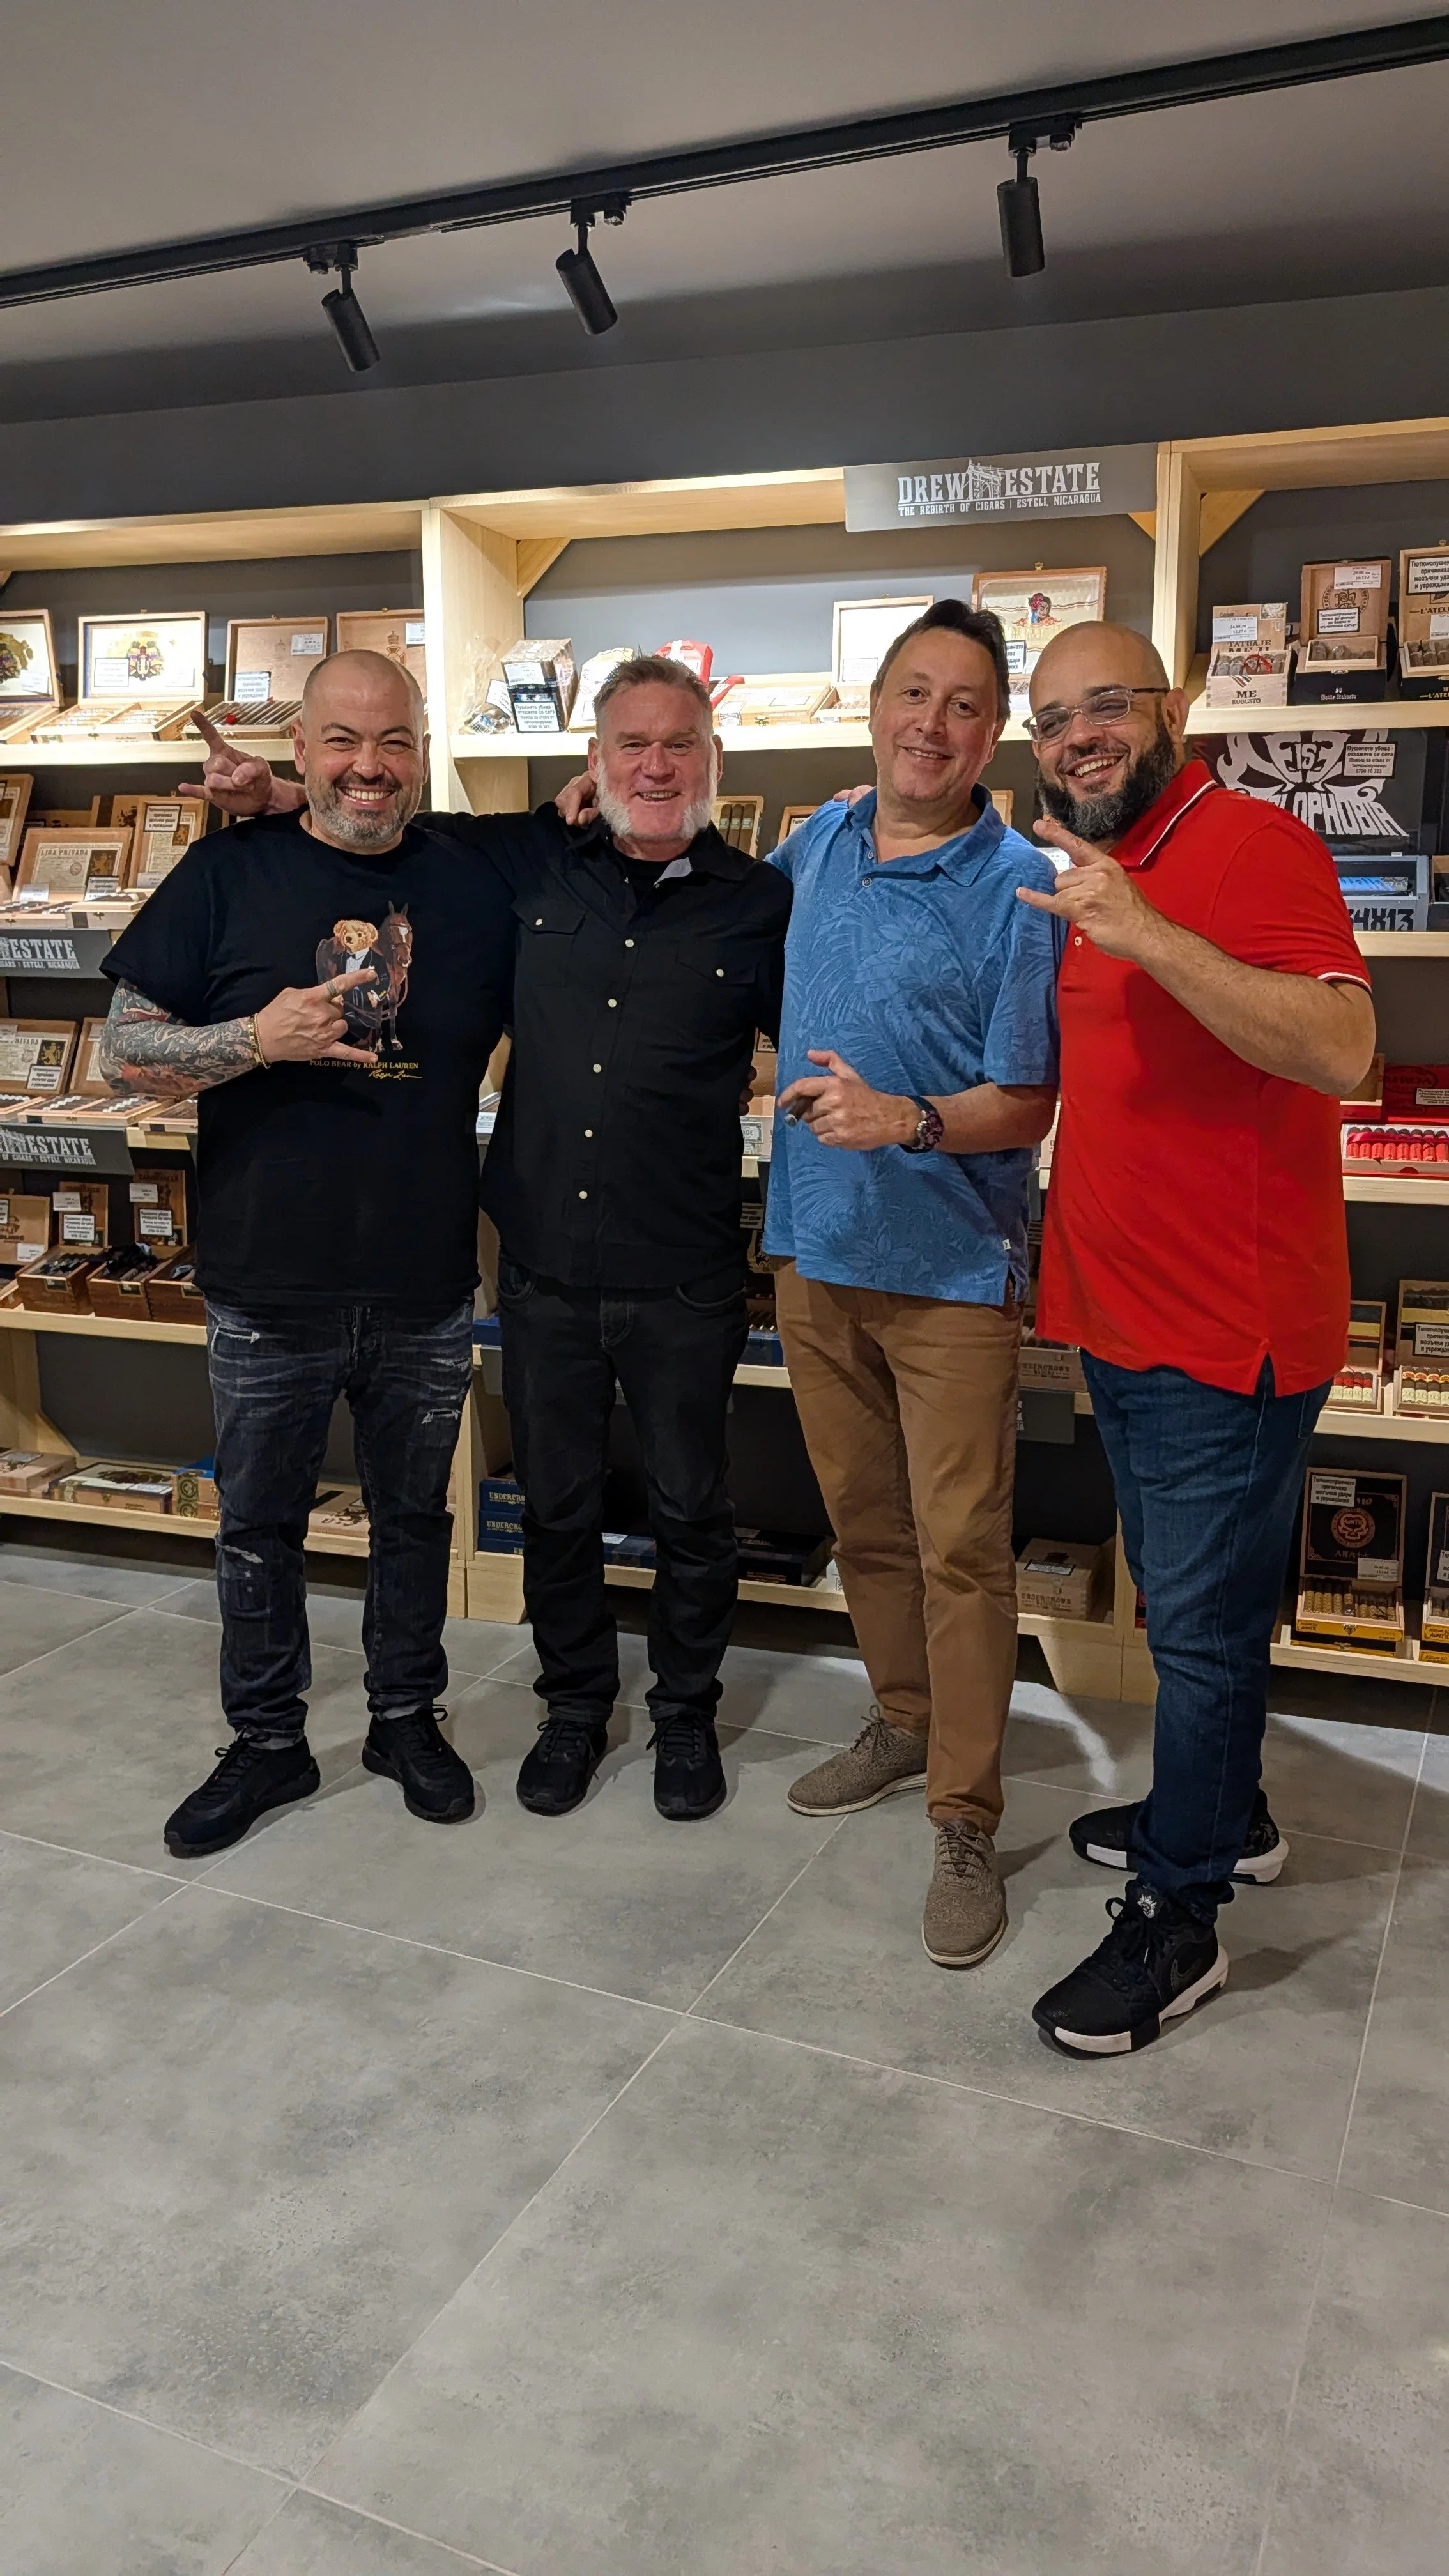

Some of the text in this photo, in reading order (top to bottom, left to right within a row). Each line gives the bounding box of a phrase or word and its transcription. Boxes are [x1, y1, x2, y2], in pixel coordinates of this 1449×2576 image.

[898, 462, 1100, 504] DREW ESTATE
[898, 507, 914, 516] THE
[920, 503, 955, 514] REBIRTH
[960, 502, 970, 512] OF
[976, 500, 1005, 511] CIGARS
[1054, 493, 1101, 506] NICARAGUA
[1236, 690, 1257, 698] ME
[9, 939, 77, 958] ESTATE
[26, 1135, 92, 1156] ESTATE
